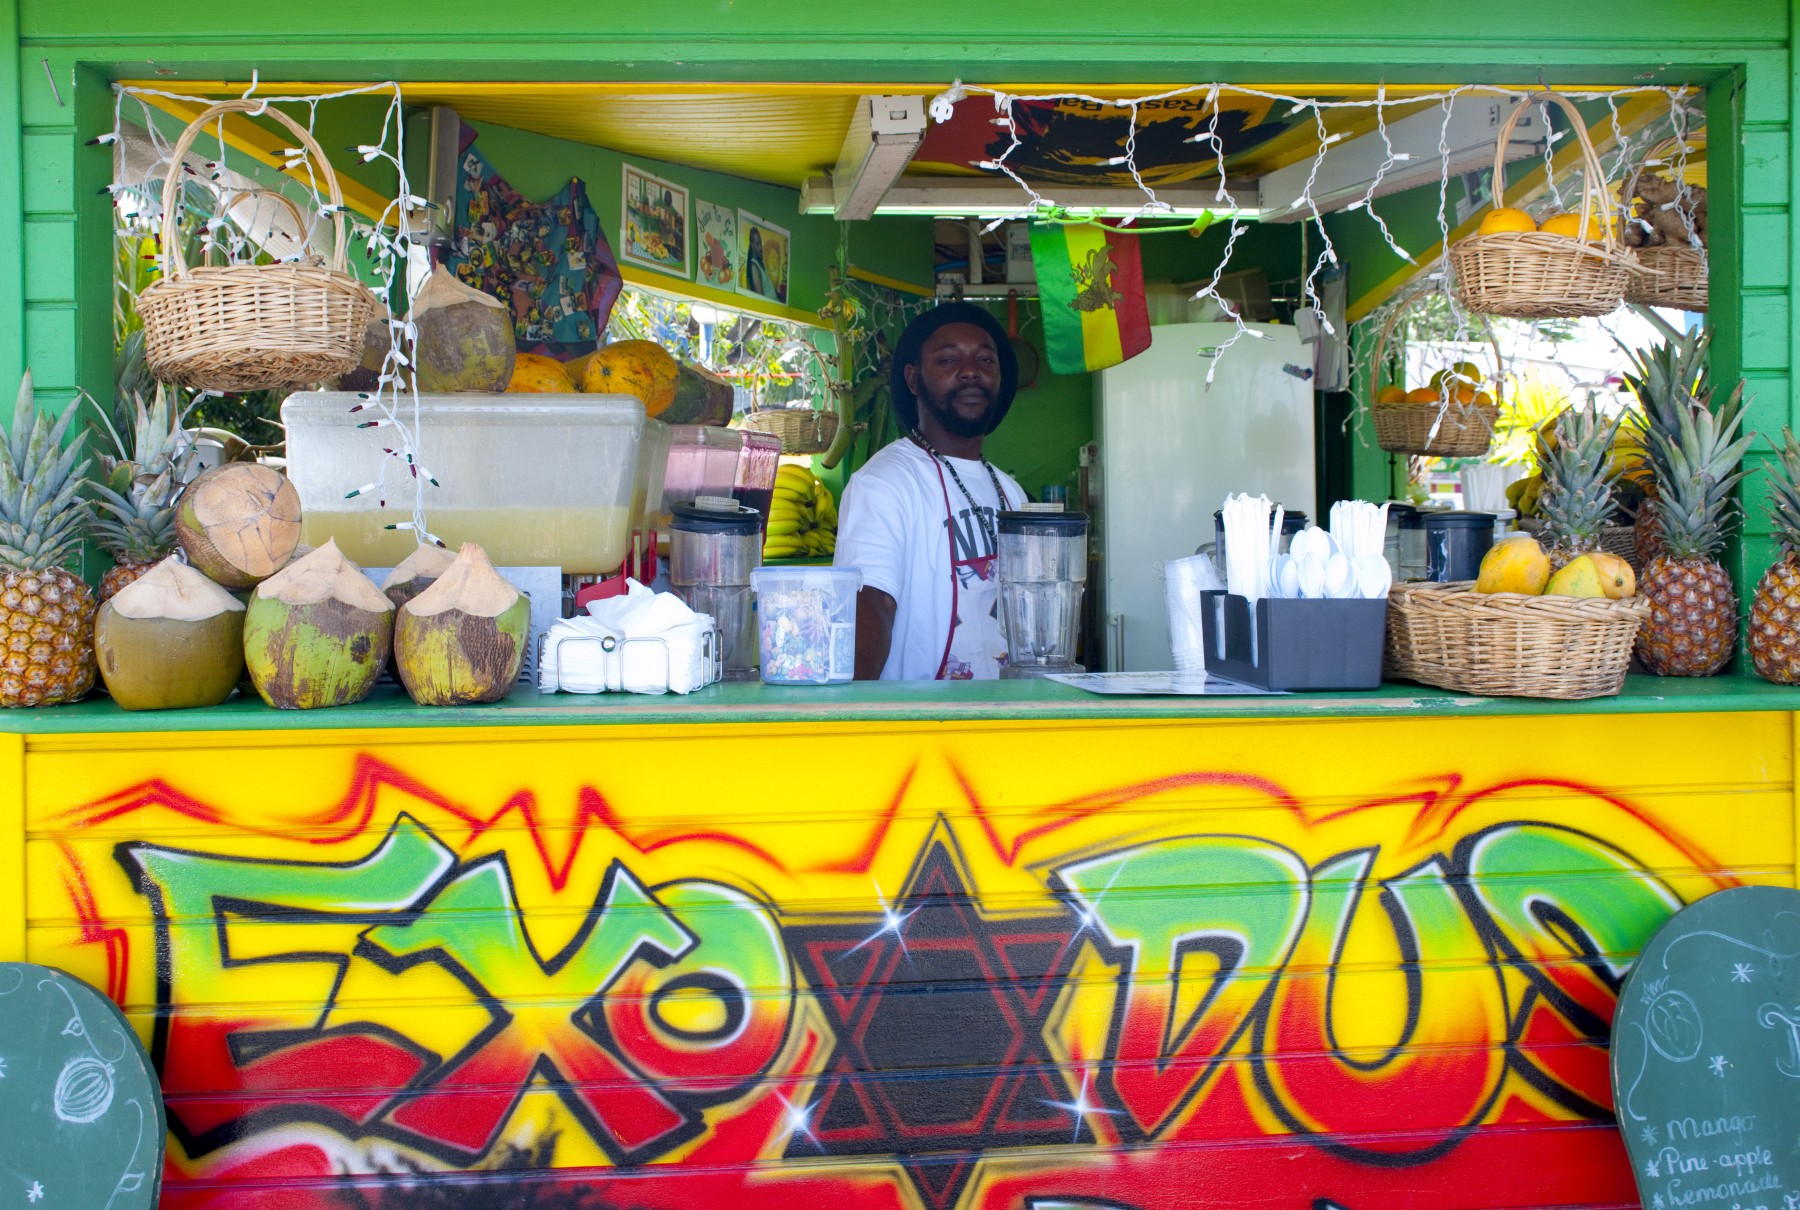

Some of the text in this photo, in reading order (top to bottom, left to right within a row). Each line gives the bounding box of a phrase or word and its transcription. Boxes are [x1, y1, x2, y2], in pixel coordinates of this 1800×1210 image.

[724, 219, 733, 236] Go
[1666, 1116, 1756, 1146] Mango
[1667, 1171, 1782, 1207] Lemonade
